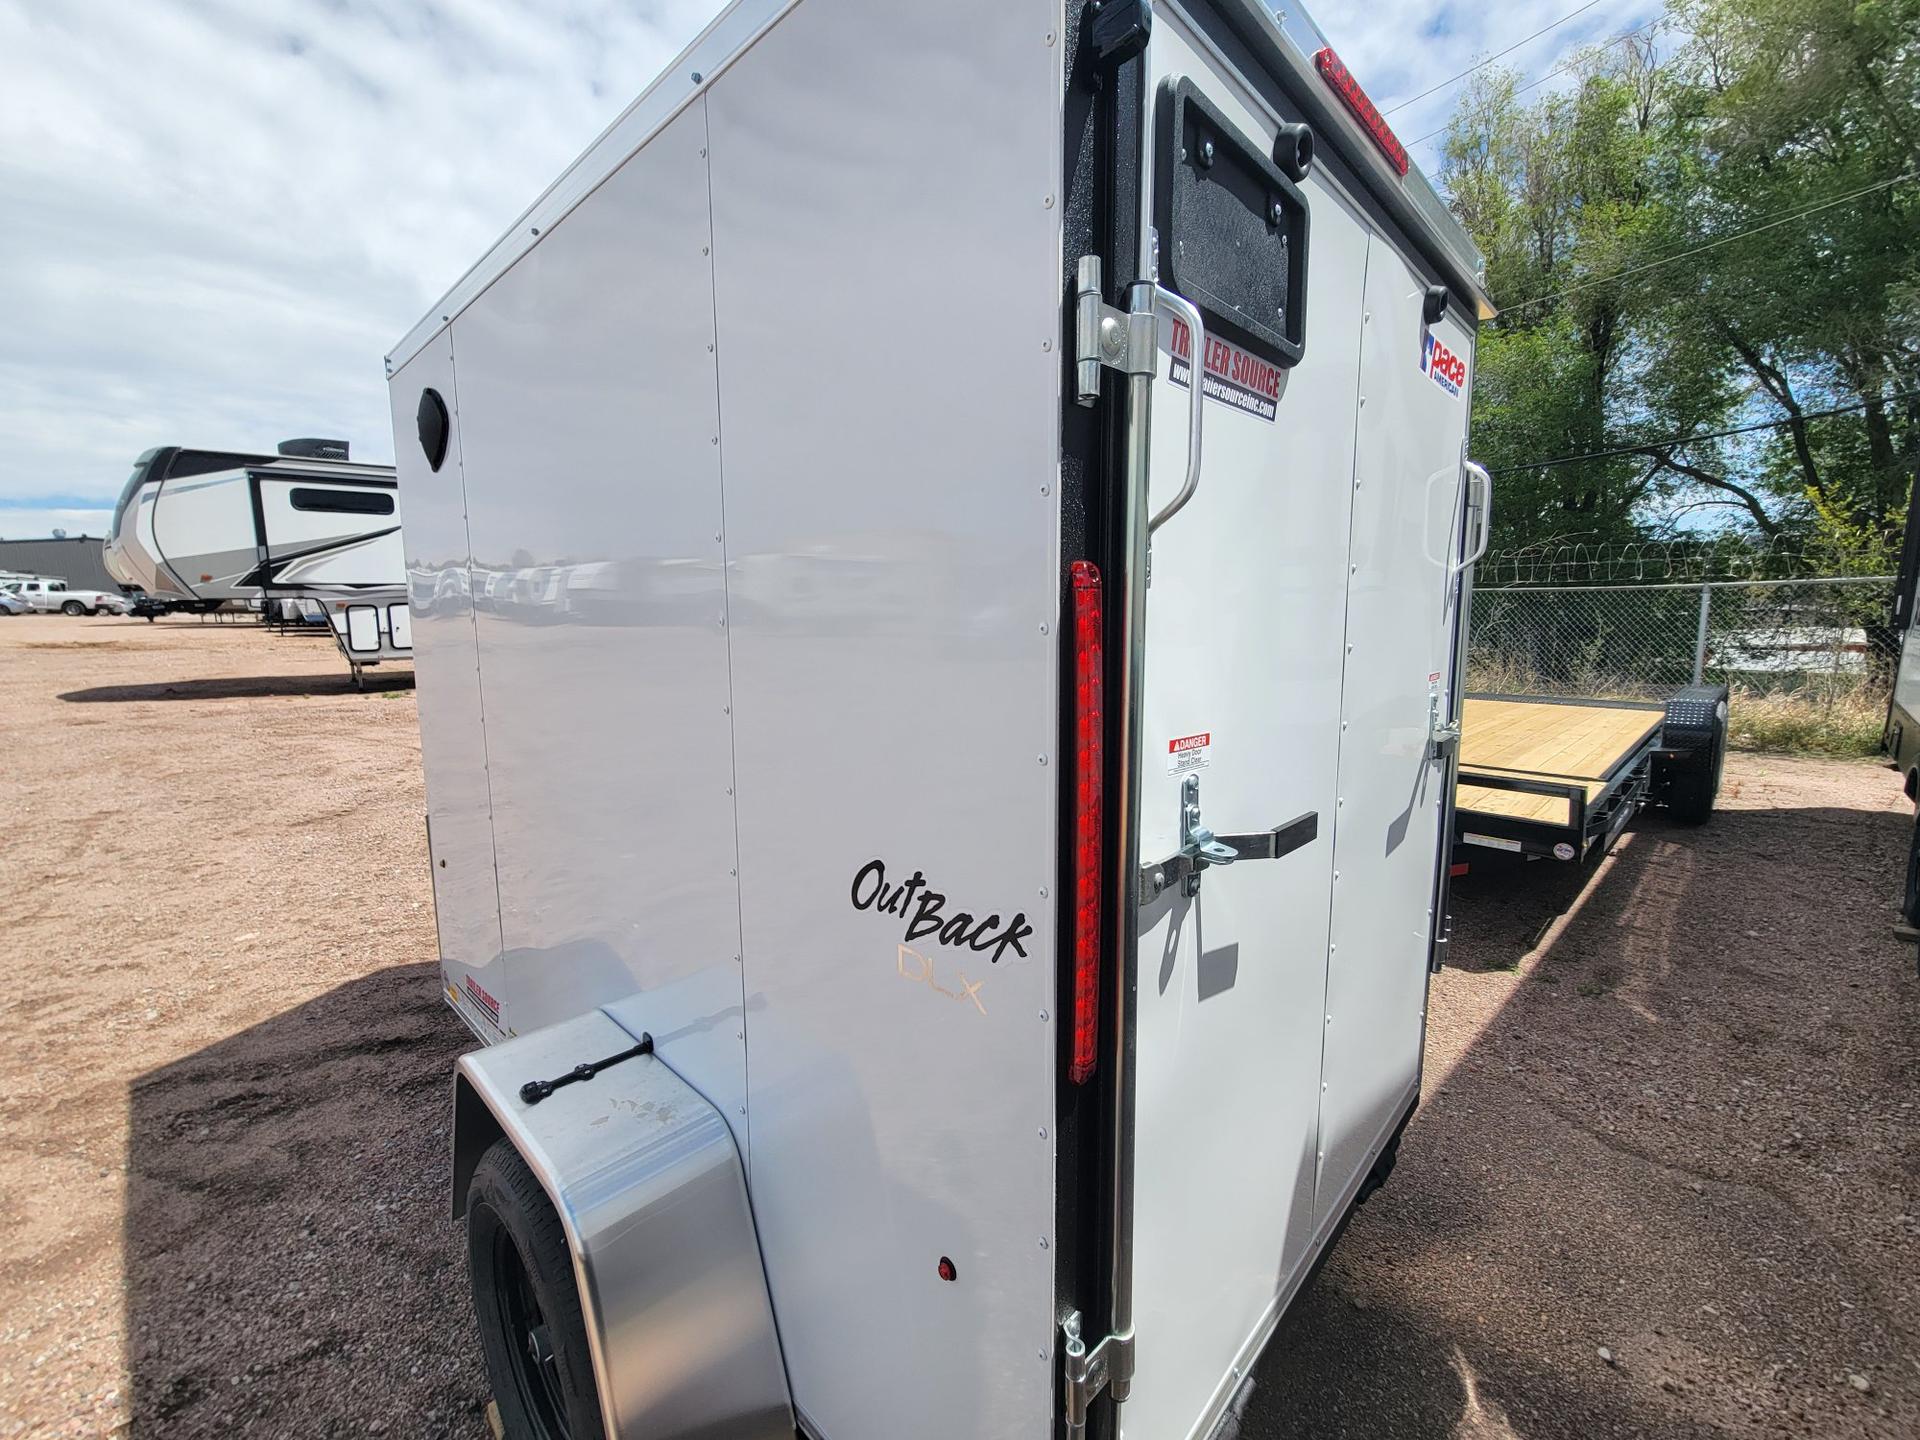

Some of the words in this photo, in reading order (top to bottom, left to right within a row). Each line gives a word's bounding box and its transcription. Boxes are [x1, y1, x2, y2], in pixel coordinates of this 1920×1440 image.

[1171, 318, 1231, 377] TRLER
[1232, 350, 1281, 399] SOURCE
[1430, 340, 1466, 388] pace
[1433, 371, 1460, 398] AMERICAN
[1180, 736, 1207, 750] DANGER
[851, 859, 1034, 964] OutBack
[897, 943, 988, 1016] DLX
